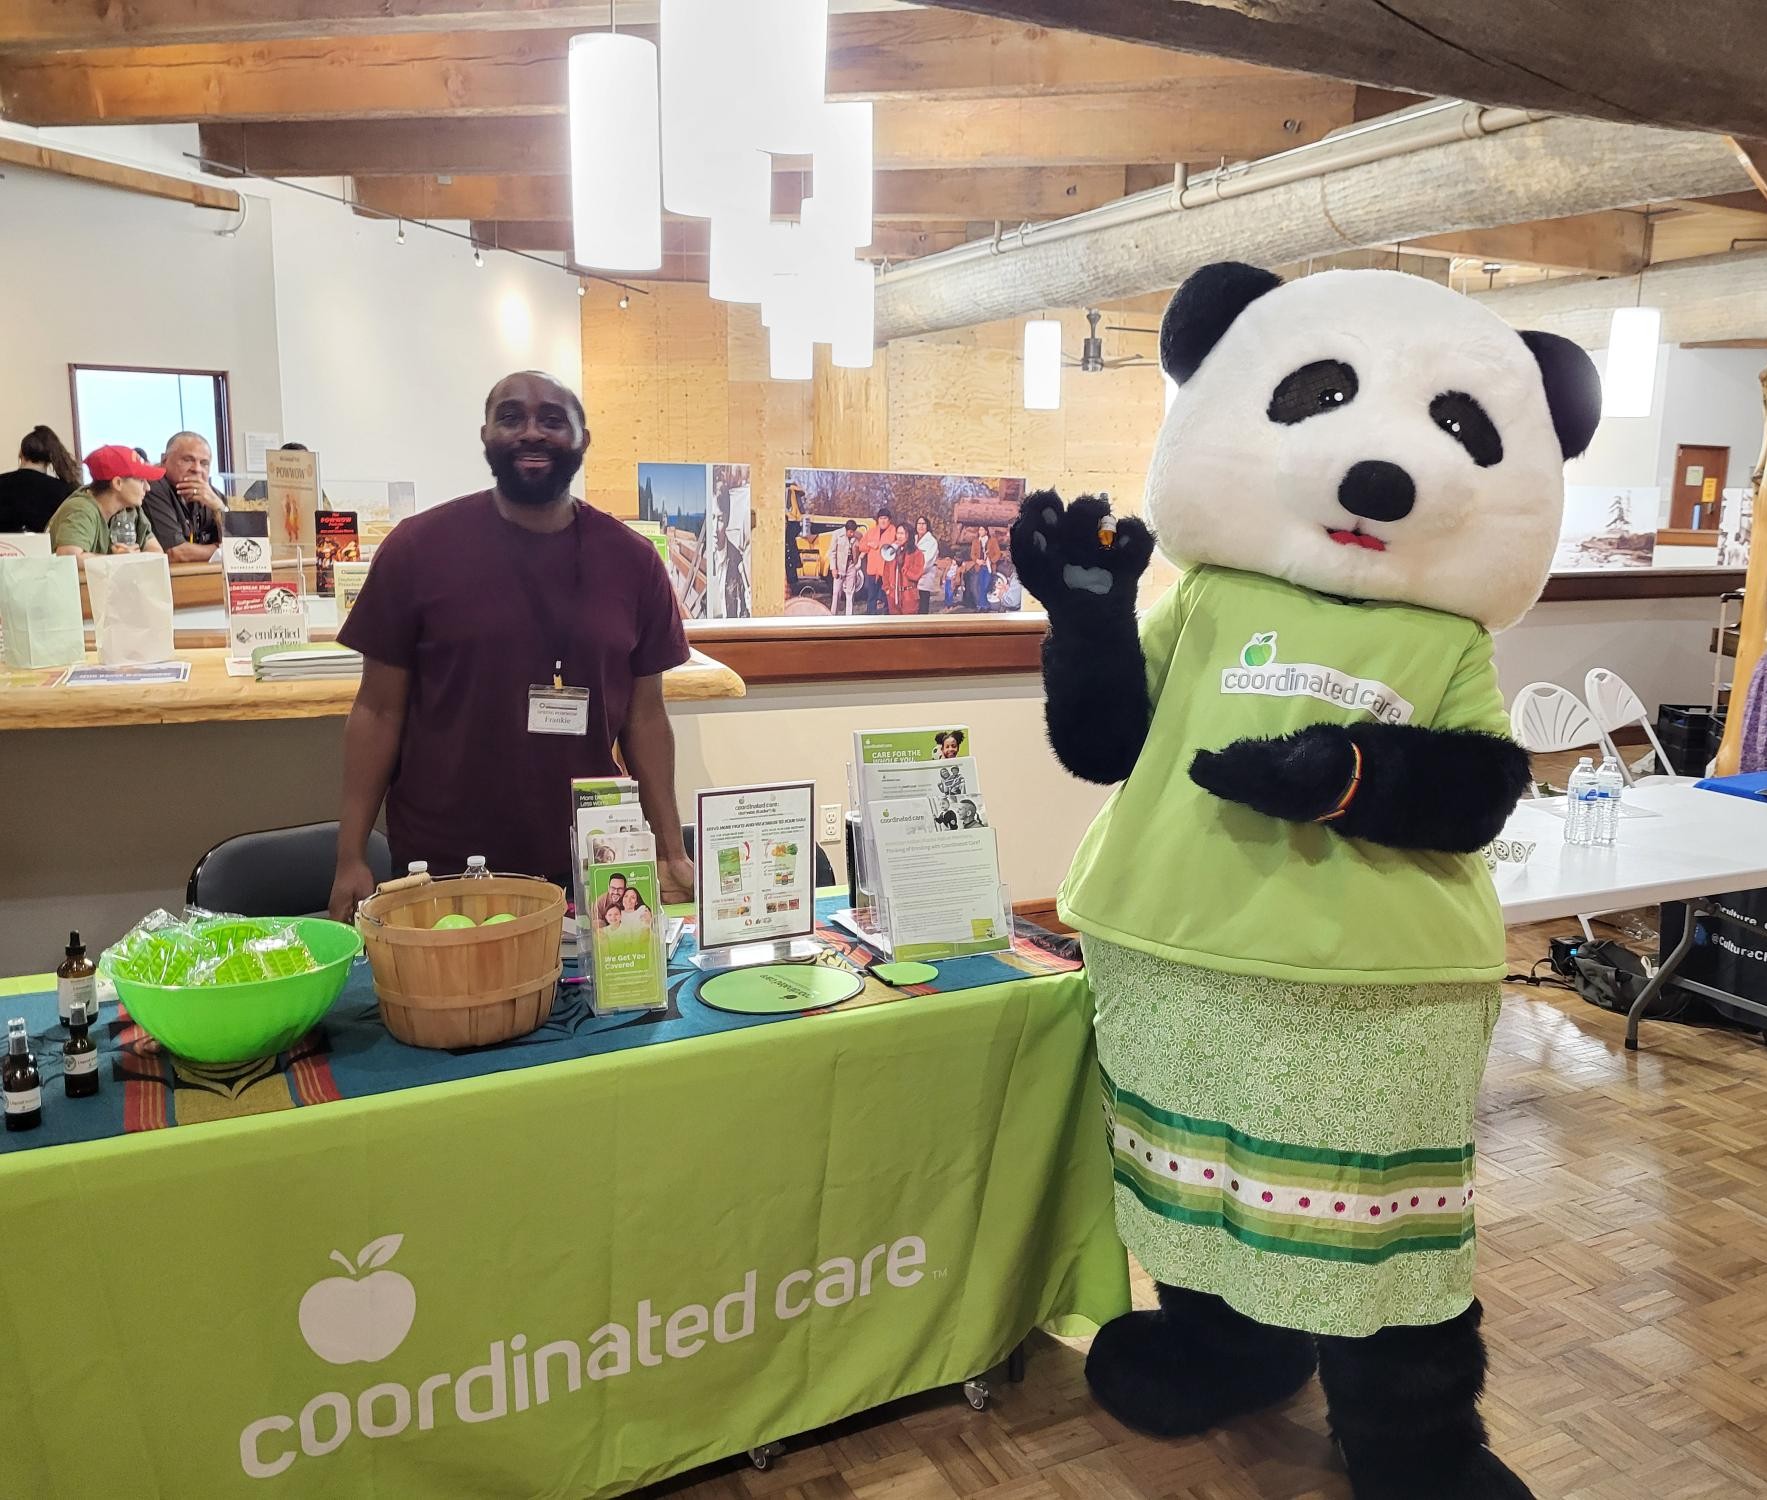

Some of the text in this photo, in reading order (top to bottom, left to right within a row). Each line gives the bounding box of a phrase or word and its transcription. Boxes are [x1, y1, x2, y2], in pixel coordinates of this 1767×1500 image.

[275, 466, 305, 480] POWWOW
[254, 627, 300, 640] embodied
[1224, 667, 1402, 724] coordinated care
[872, 749, 921, 759] CARE FOR THE
[880, 816, 912, 824] coordinated
[604, 953, 646, 963] We Get You
[604, 961, 635, 970] Covered
[240, 1235, 949, 1478] coordinated care TM
